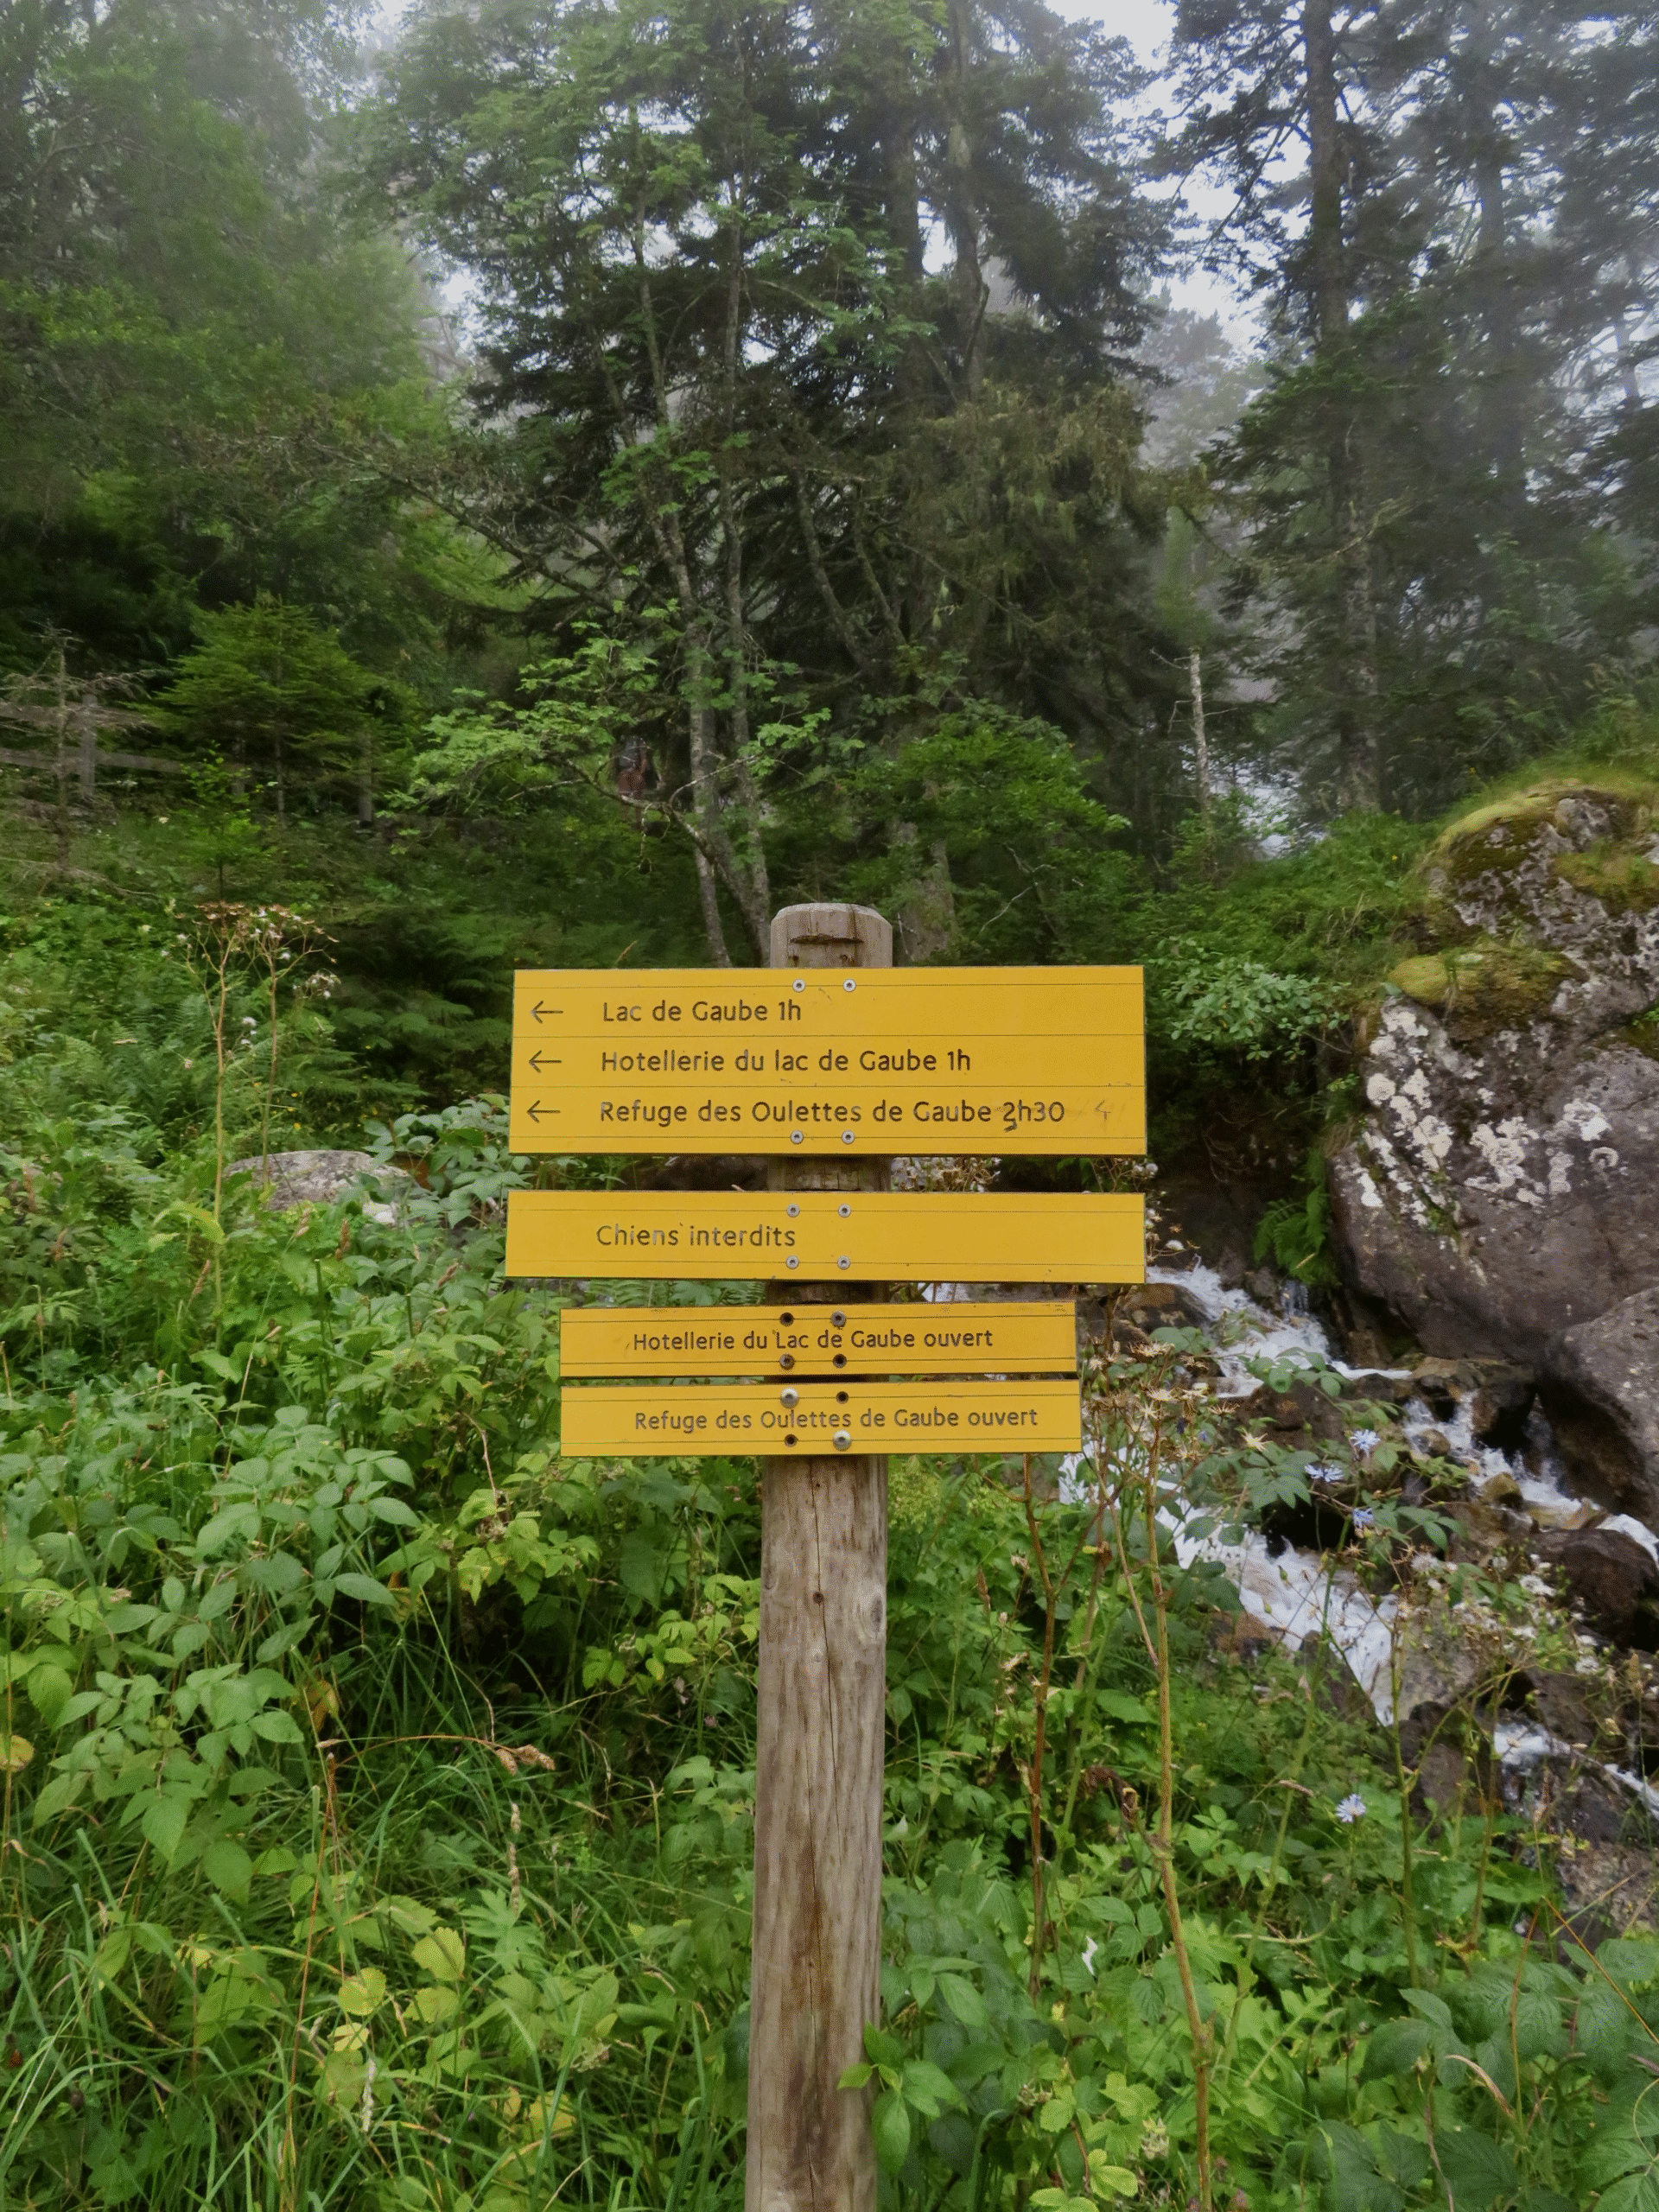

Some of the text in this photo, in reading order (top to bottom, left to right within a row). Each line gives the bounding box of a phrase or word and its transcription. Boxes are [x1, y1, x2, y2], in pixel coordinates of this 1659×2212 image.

[603, 999, 801, 1022] Lac de Gaube 1h
[601, 1049, 970, 1071] Hotellerie du lac de Gaube 1h
[601, 1099, 1065, 1128] Refuge des Oulettes de Gaube 2h30
[596, 1224, 796, 1247] Chiens interdits
[634, 1329, 993, 1351] Hotellerie du Lac de Gaube ouvert
[635, 1406, 1039, 1434] Refuge des Oulettes de Gaube ouvert
